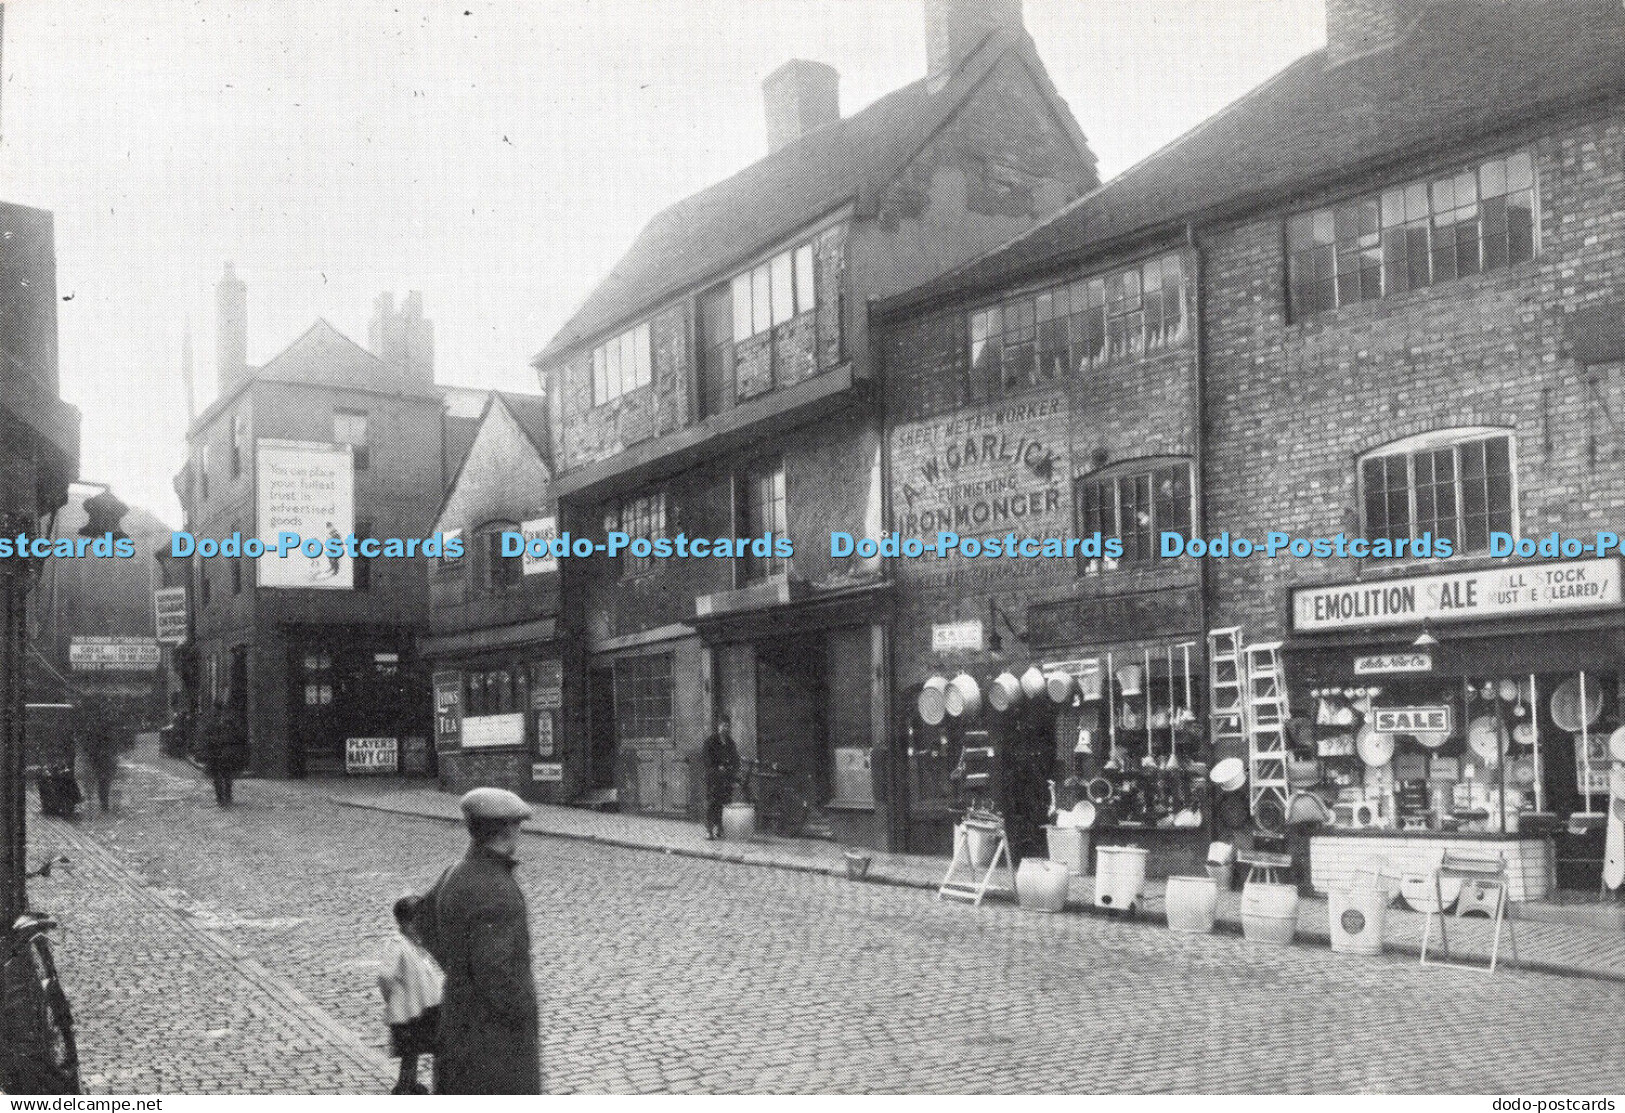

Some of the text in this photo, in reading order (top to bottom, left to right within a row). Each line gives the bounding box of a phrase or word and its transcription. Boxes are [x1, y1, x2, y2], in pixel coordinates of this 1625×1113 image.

[946, 414, 993, 437] METAL
[995, 398, 1060, 425] WORKER
[269, 463, 336, 478] You can place
[270, 478, 336, 490] your fullest
[939, 476, 1019, 502] FURNISHING
[269, 490, 297, 501] trust
[269, 502, 336, 515] advertised
[899, 489, 1061, 540] IRONMONGER
[269, 516, 303, 528] goods
[1534, 567, 1586, 585] STOCK
[1543, 579, 1609, 600] CLEARED!
[1302, 580, 1478, 623] DEMOLITION SALE
[439, 716, 457, 733] TEA
[1379, 712, 1445, 729] SALE
[347, 750, 375, 764] NAVY
[376, 750, 397, 764] CUT
